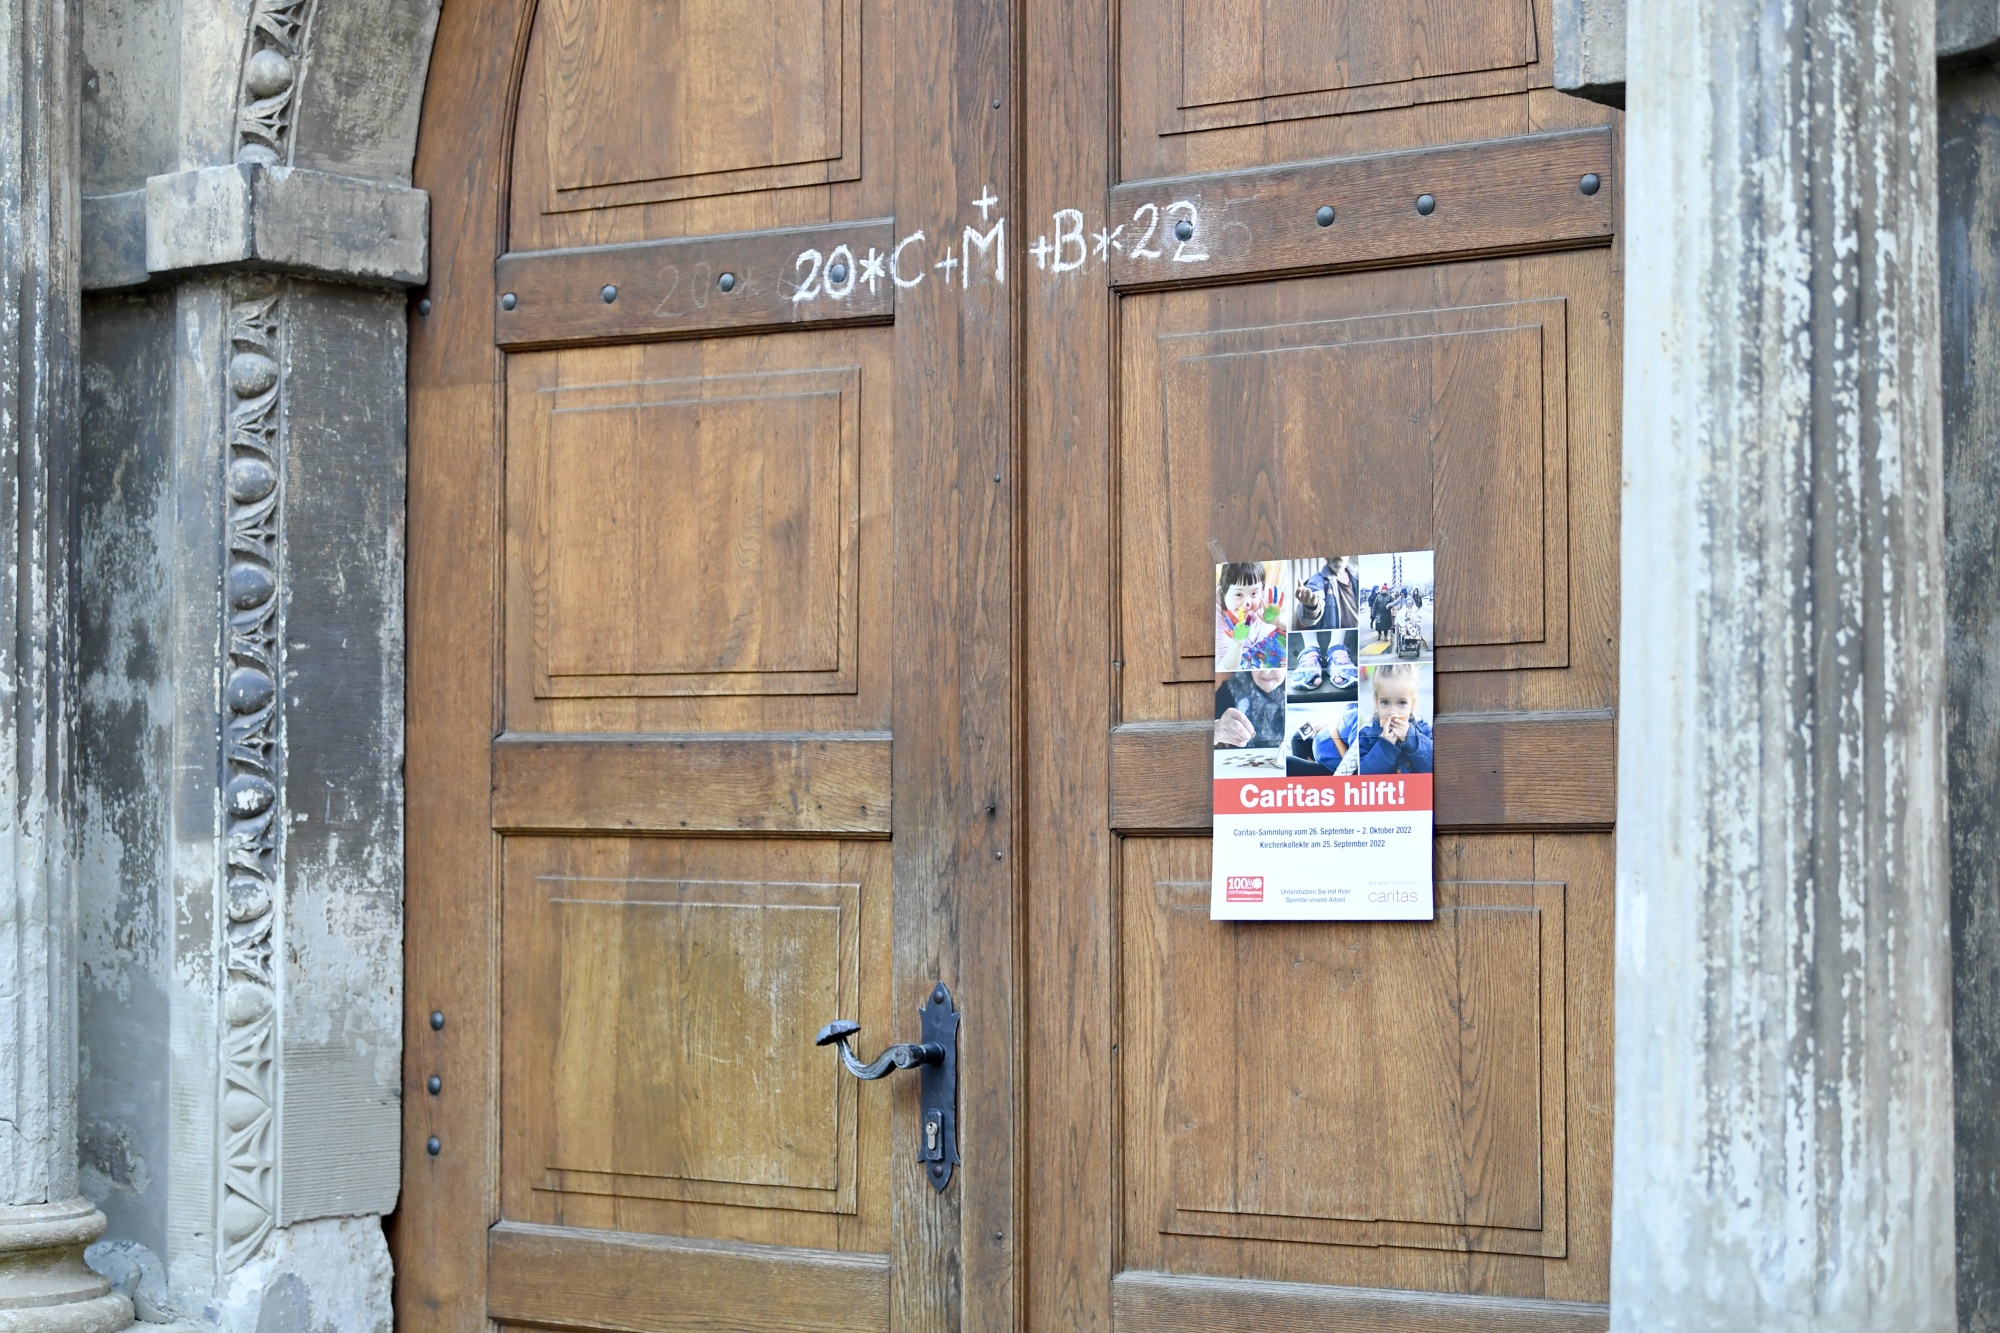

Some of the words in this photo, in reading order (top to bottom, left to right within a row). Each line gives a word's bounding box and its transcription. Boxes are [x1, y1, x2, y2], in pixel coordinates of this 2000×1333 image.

[1239, 783, 1335, 808] Caritas
[1344, 781, 1405, 805] hilft!
[1234, 828, 1292, 837] Caritas-Sammlung
[1321, 827, 1354, 836] September
[1334, 840, 1368, 849] September
[1228, 877, 1247, 889] 100
[1368, 889, 1418, 903] caritas
